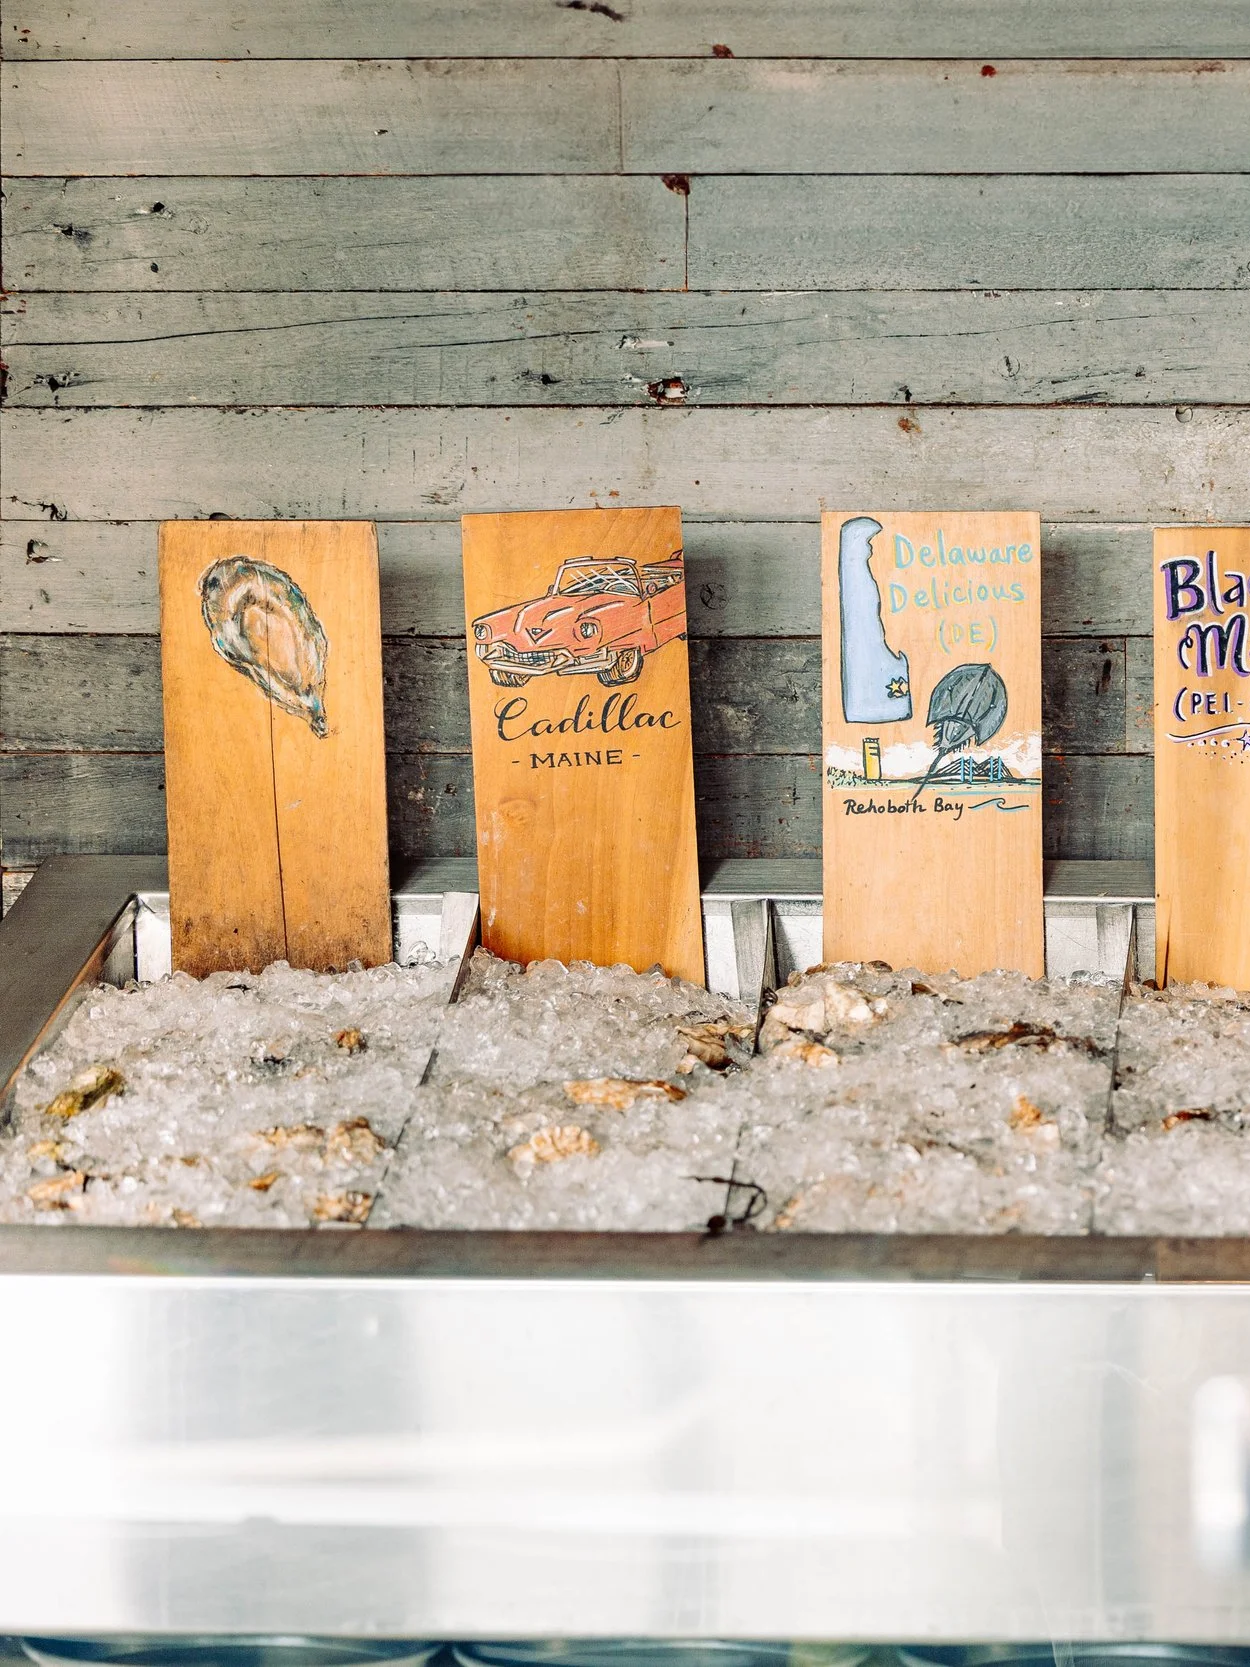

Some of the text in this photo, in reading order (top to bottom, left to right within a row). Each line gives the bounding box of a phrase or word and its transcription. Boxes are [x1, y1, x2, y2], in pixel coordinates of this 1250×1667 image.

[893, 529, 1034, 569] Delaware
[889, 579, 1027, 614] Delicious
[938, 616, 999, 653] (DE)
[494, 692, 681, 741] Cadillac
[530, 750, 623, 769] MAINE
[843, 797, 964, 821] Rehoboth Bay
